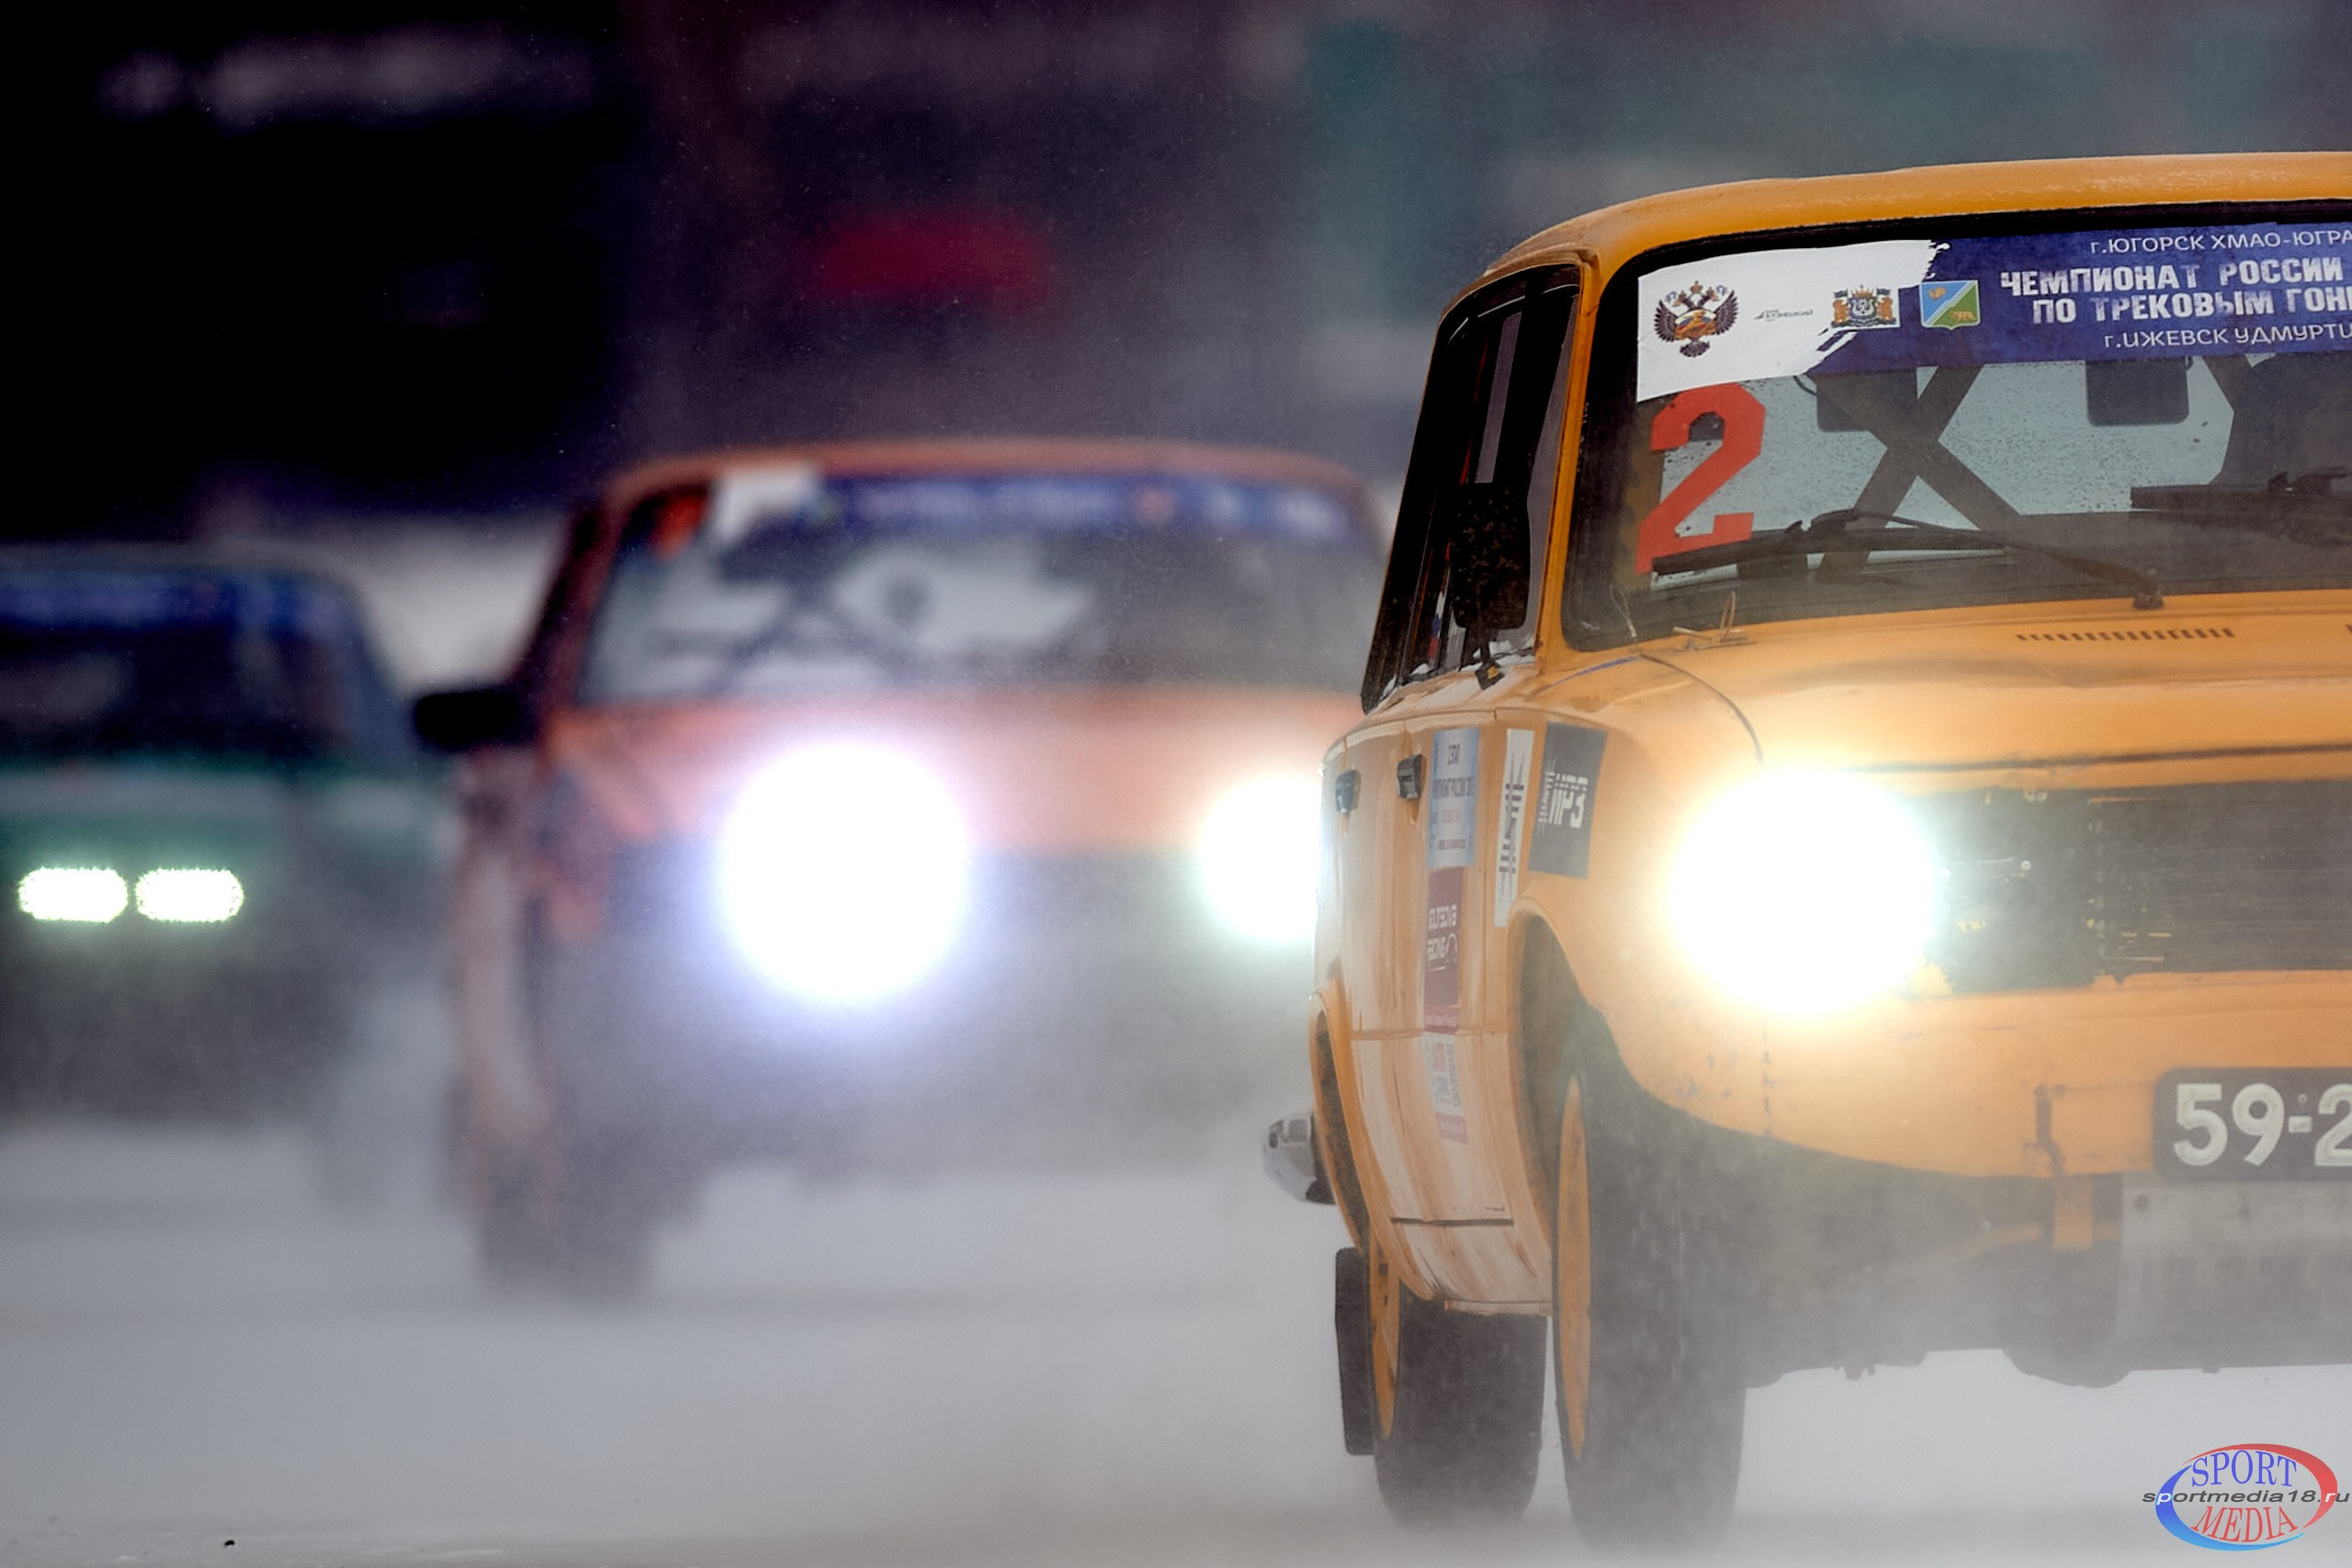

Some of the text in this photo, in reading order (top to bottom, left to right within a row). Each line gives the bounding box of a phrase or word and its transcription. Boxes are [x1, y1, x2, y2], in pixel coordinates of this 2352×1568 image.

[2090, 235, 2205, 254] г.ЮГОРСК
[2000, 257, 2344, 297] ЧЕМПИОНАТ РОССИИ
[2033, 298, 2076, 324] ПО
[2090, 290, 2275, 321] ТРЕКОВЫМ
[2104, 329, 2229, 348] г.ИЖЕВСК
[1635, 382, 1766, 576] 2
